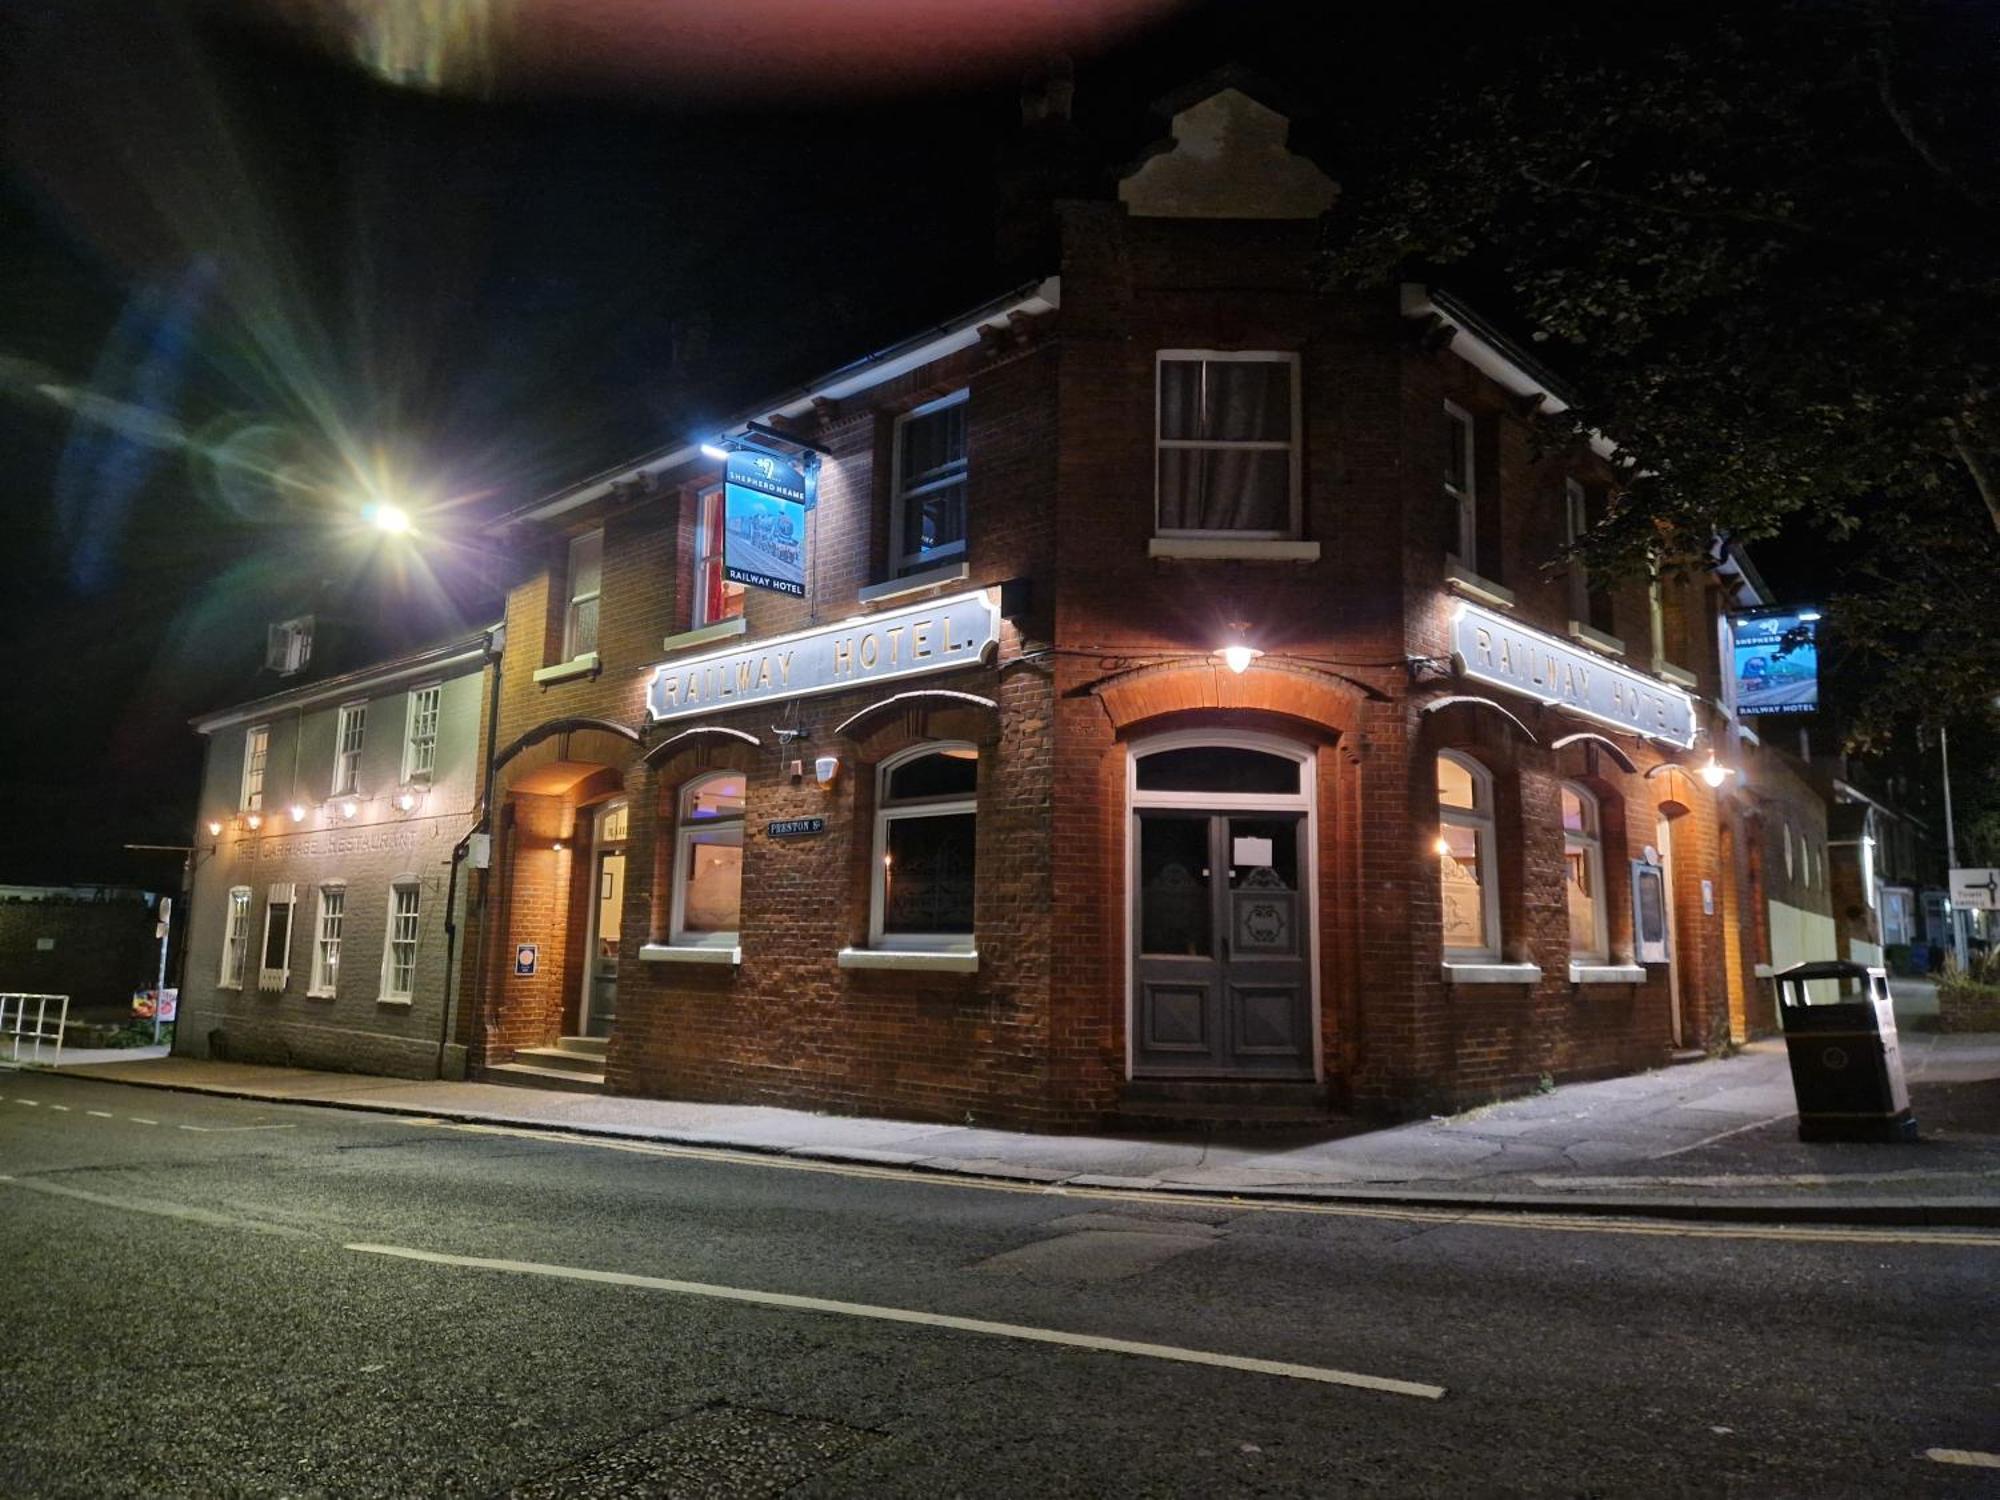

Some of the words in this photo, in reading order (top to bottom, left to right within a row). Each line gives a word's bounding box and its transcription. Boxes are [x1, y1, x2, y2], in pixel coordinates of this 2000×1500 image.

[730, 471, 776, 491] SHEPHERD
[776, 485, 805, 500] NEAME
[730, 570, 770, 586] RAILWAY
[773, 580, 803, 594] HOTEL
[1476, 627, 1591, 698] RAILWAY
[664, 651, 794, 706] RAILWAY
[1739, 705, 1780, 715] RAILWAY
[1783, 704, 1815, 712] HOTEL
[771, 821, 810, 833] PRESTON
[326, 831, 417, 856] RESTAURANT
